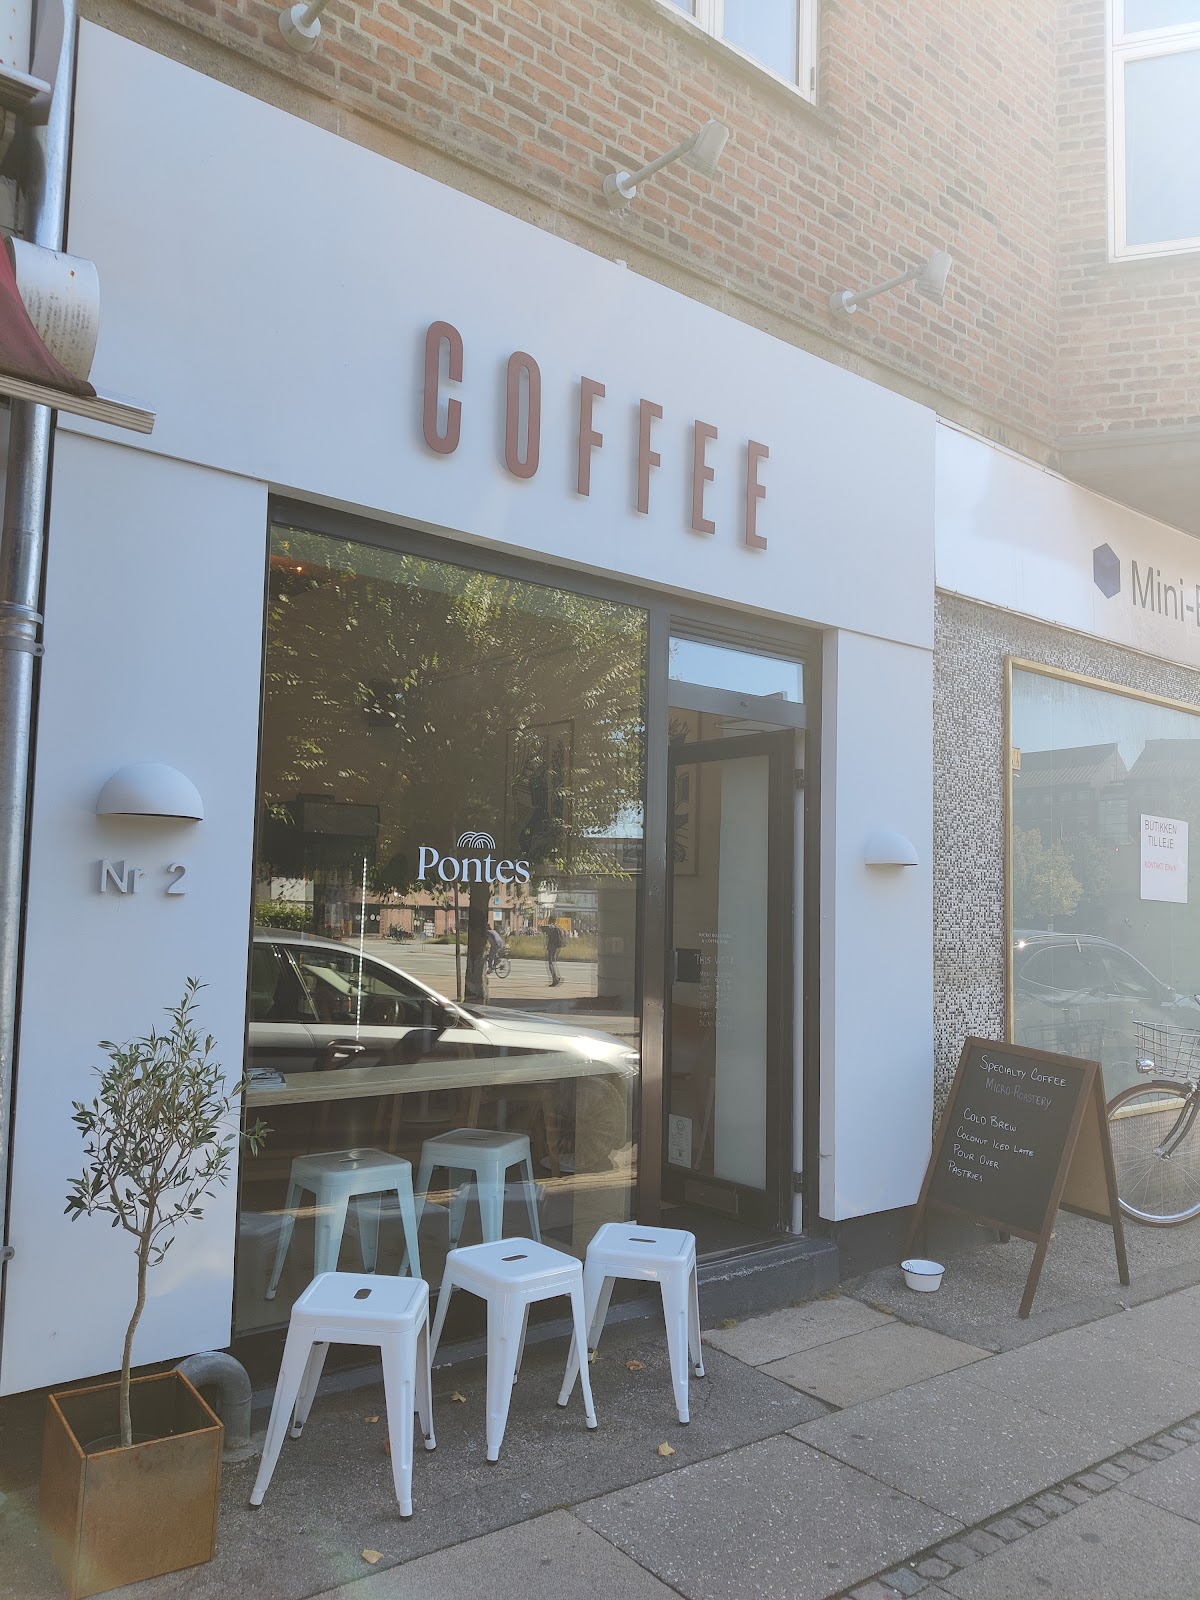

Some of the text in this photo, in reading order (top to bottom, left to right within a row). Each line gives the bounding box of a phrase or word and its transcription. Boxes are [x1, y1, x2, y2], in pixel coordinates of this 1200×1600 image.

[423, 321, 769, 550] COFFEE
[1145, 820, 1177, 834] BUTIKKEN
[99, 859, 187, 895] Nr 2
[417, 846, 531, 884] Pontes
[979, 1054, 1067, 1087] SPECIALTY COFFEE
[963, 1107, 1017, 1132] COLD BREW
[953, 1143, 1000, 1170] POUR OVER
[956, 1125, 1035, 1157] COCONUT ICED LATTE
[948, 1159, 983, 1183] PASTRIES
